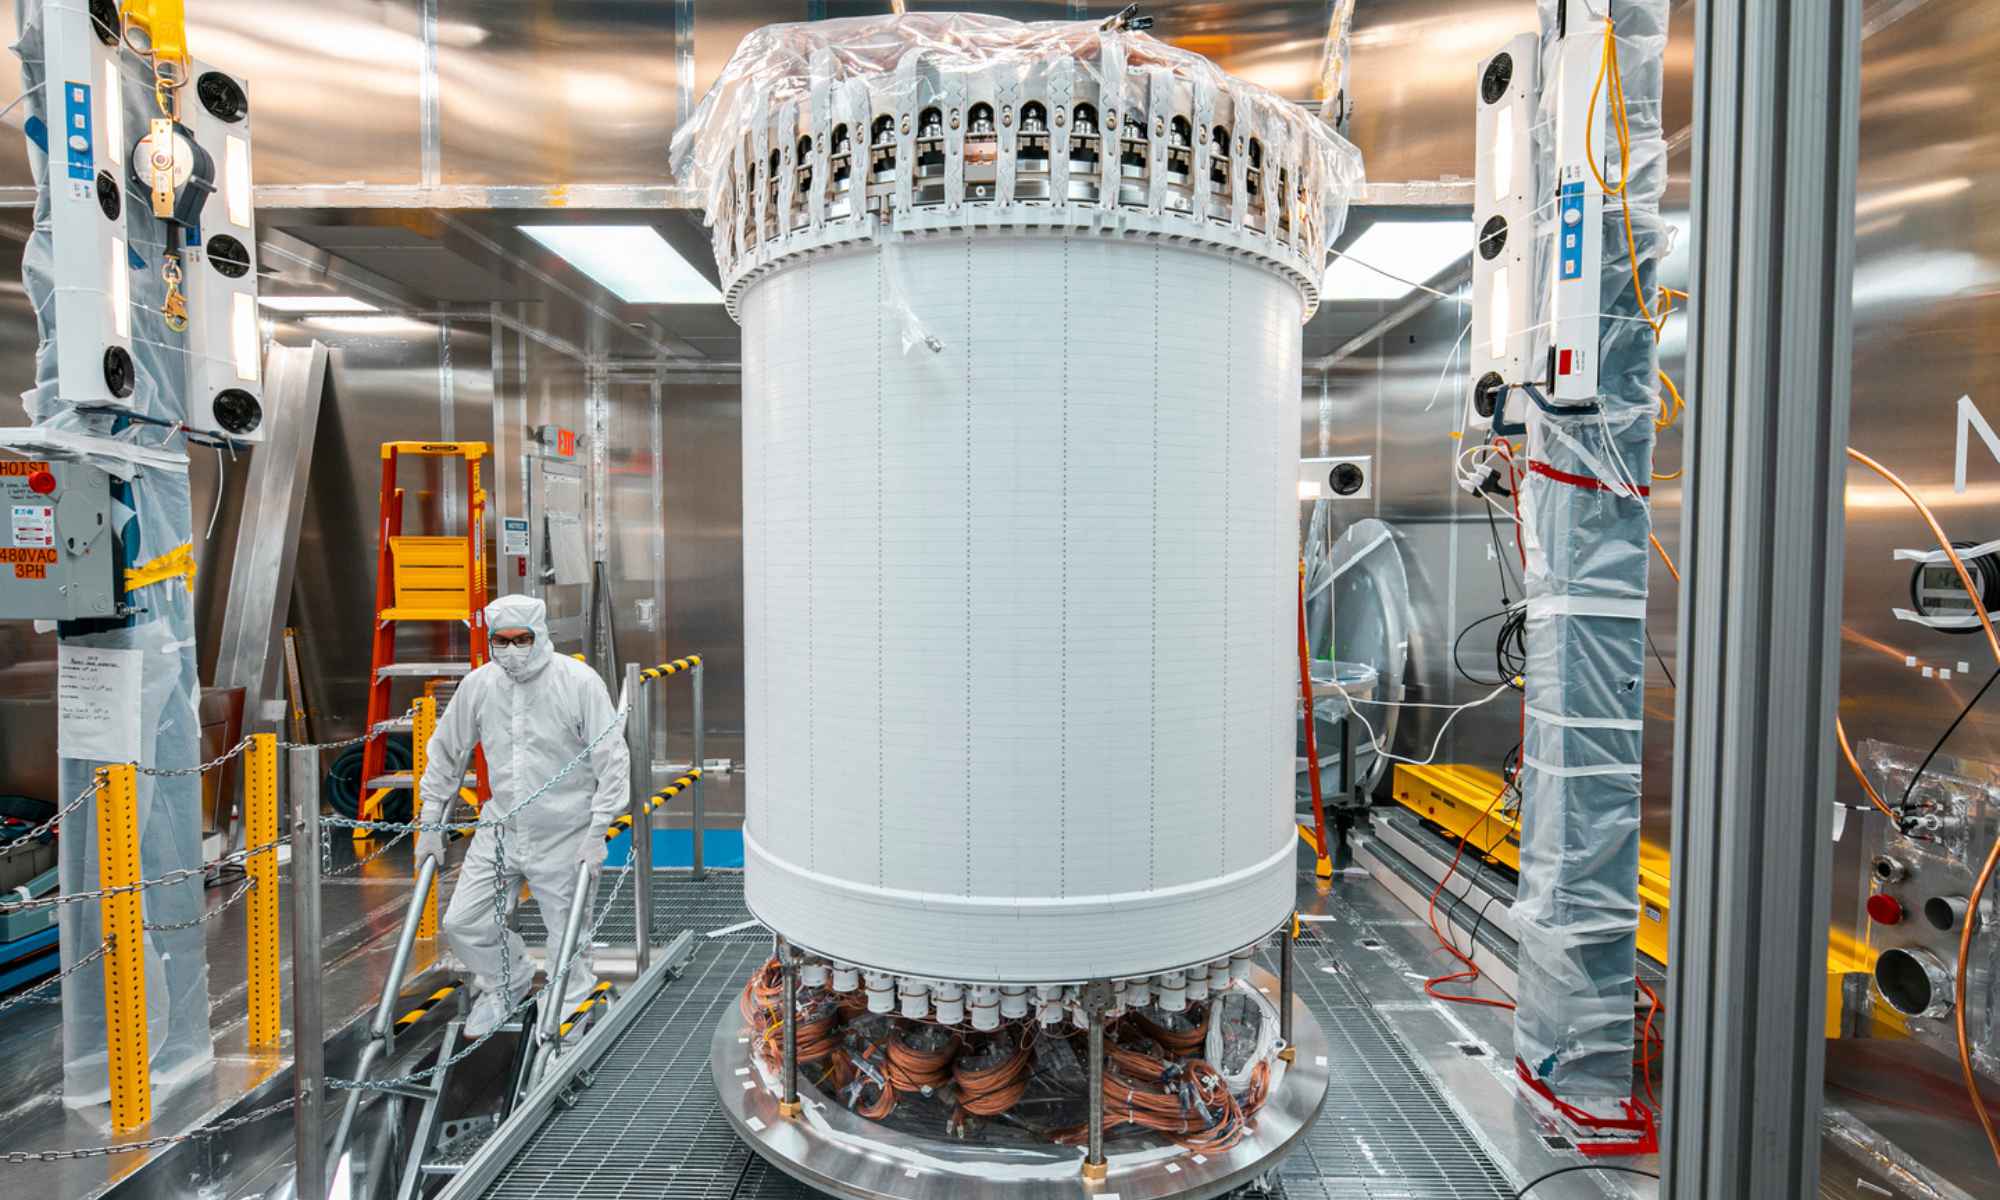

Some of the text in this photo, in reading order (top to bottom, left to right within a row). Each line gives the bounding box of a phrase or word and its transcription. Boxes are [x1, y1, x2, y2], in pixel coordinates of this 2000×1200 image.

[558, 430, 575, 456] EXIT
[0, 462, 47, 475] HOIST
[0, 548, 57, 563] 480VAC
[15, 564, 46, 578] 3PH
